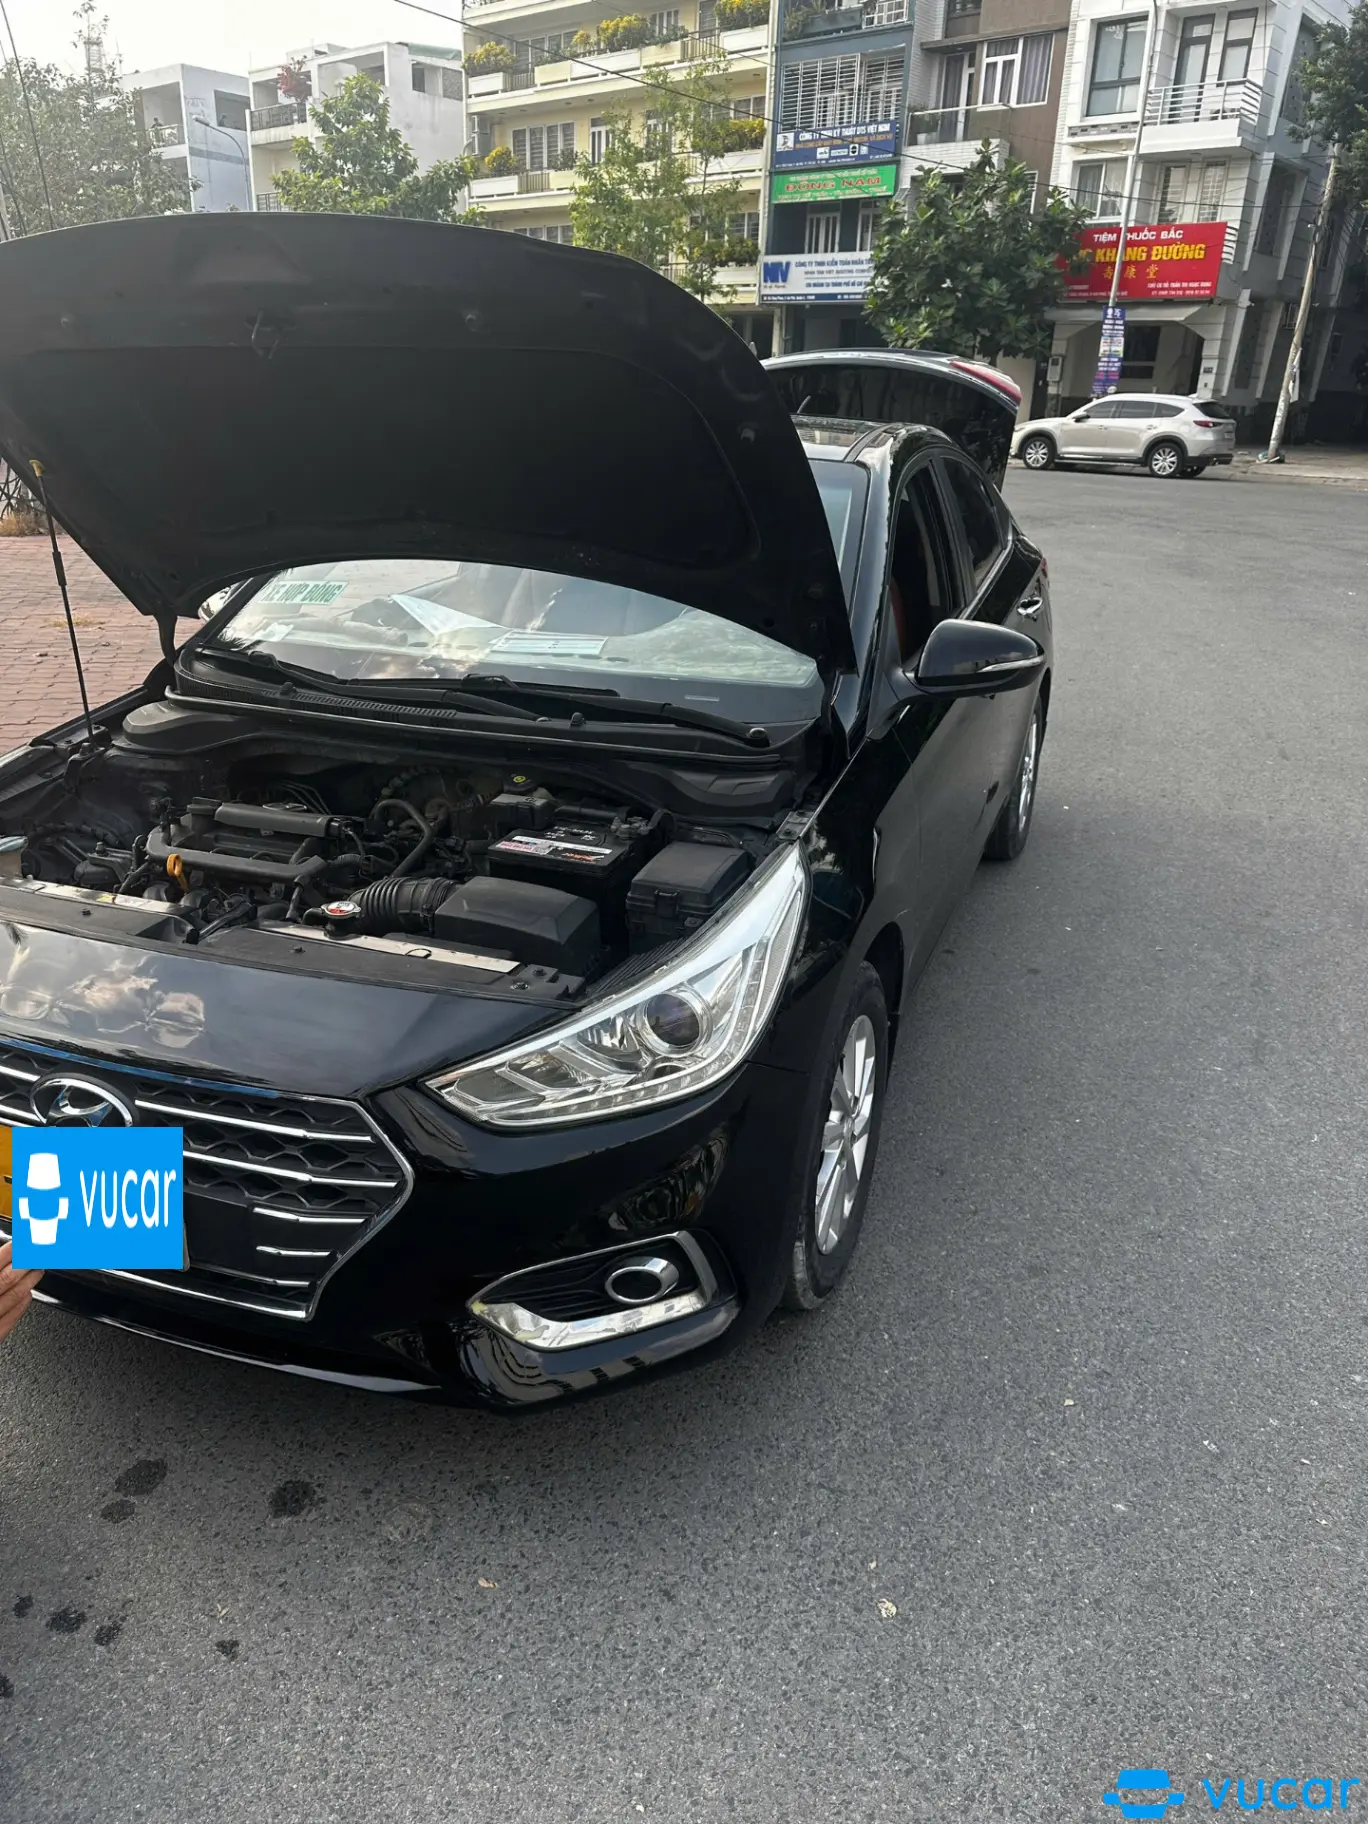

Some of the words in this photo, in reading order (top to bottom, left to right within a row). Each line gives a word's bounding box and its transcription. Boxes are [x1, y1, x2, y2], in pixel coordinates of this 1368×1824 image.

[840, 177, 881, 188] NAM
[1093, 231, 1117, 243] TIỆM
[1123, 226, 1156, 241] HUỐC
[1160, 226, 1184, 240] BẮC
[1095, 246, 1147, 262] KHNG
[1151, 241, 1206, 260] ĐƯỜNG
